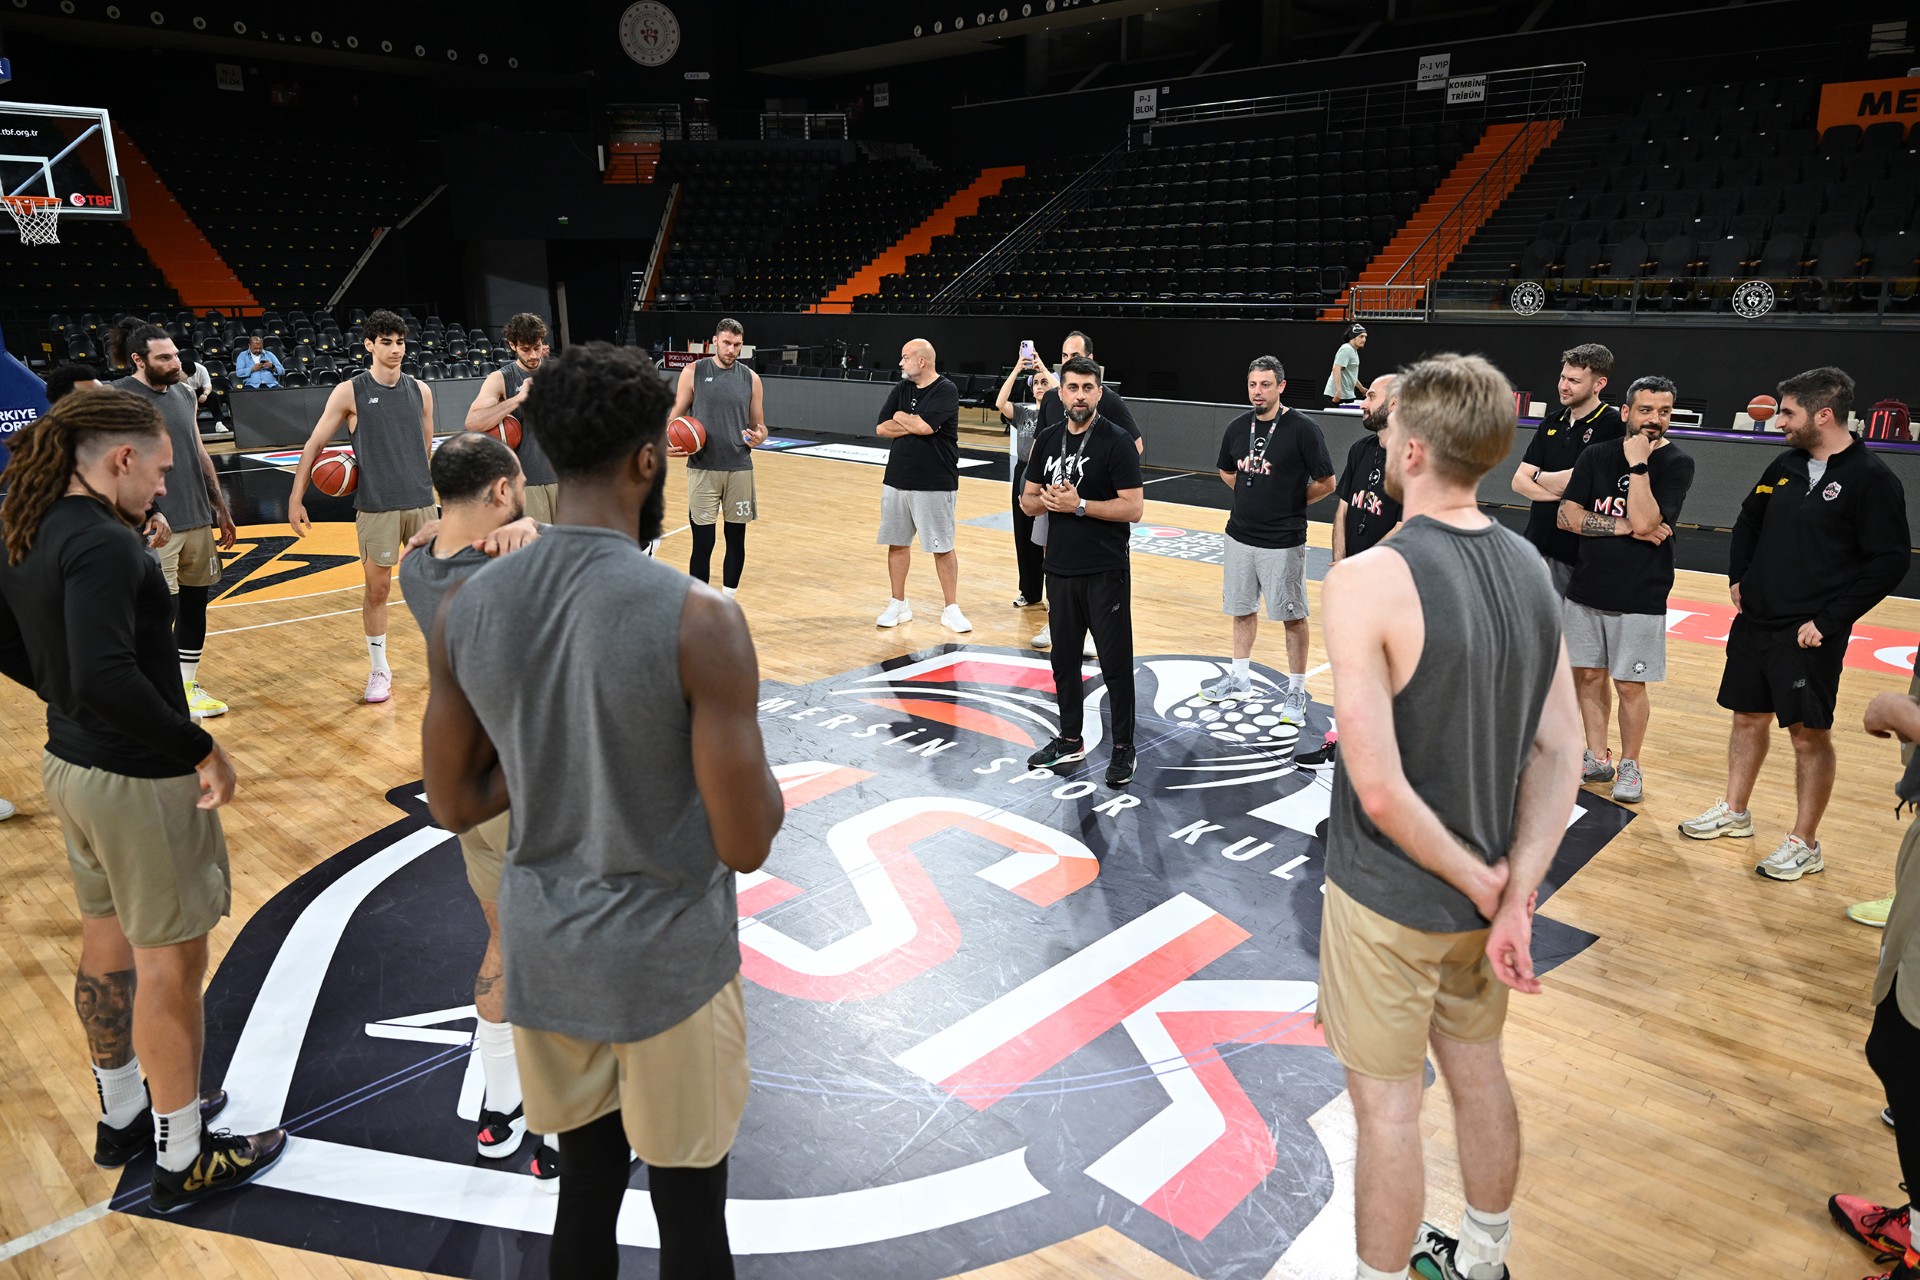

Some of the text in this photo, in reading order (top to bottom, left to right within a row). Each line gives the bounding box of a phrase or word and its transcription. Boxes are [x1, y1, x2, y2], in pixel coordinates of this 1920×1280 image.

[1139, 95, 1151, 103] P-1
[1451, 90, 1481, 101] TRİBÜN
[1857, 88, 1920, 117] ME
[1135, 105, 1155, 114] BLOK
[85, 195, 113, 206] TBF
[0, 420, 36, 433] ORT
[736, 501, 751, 516] 33
[972, 757, 1141, 818] SPOR
[1168, 819, 1326, 895] KUL
